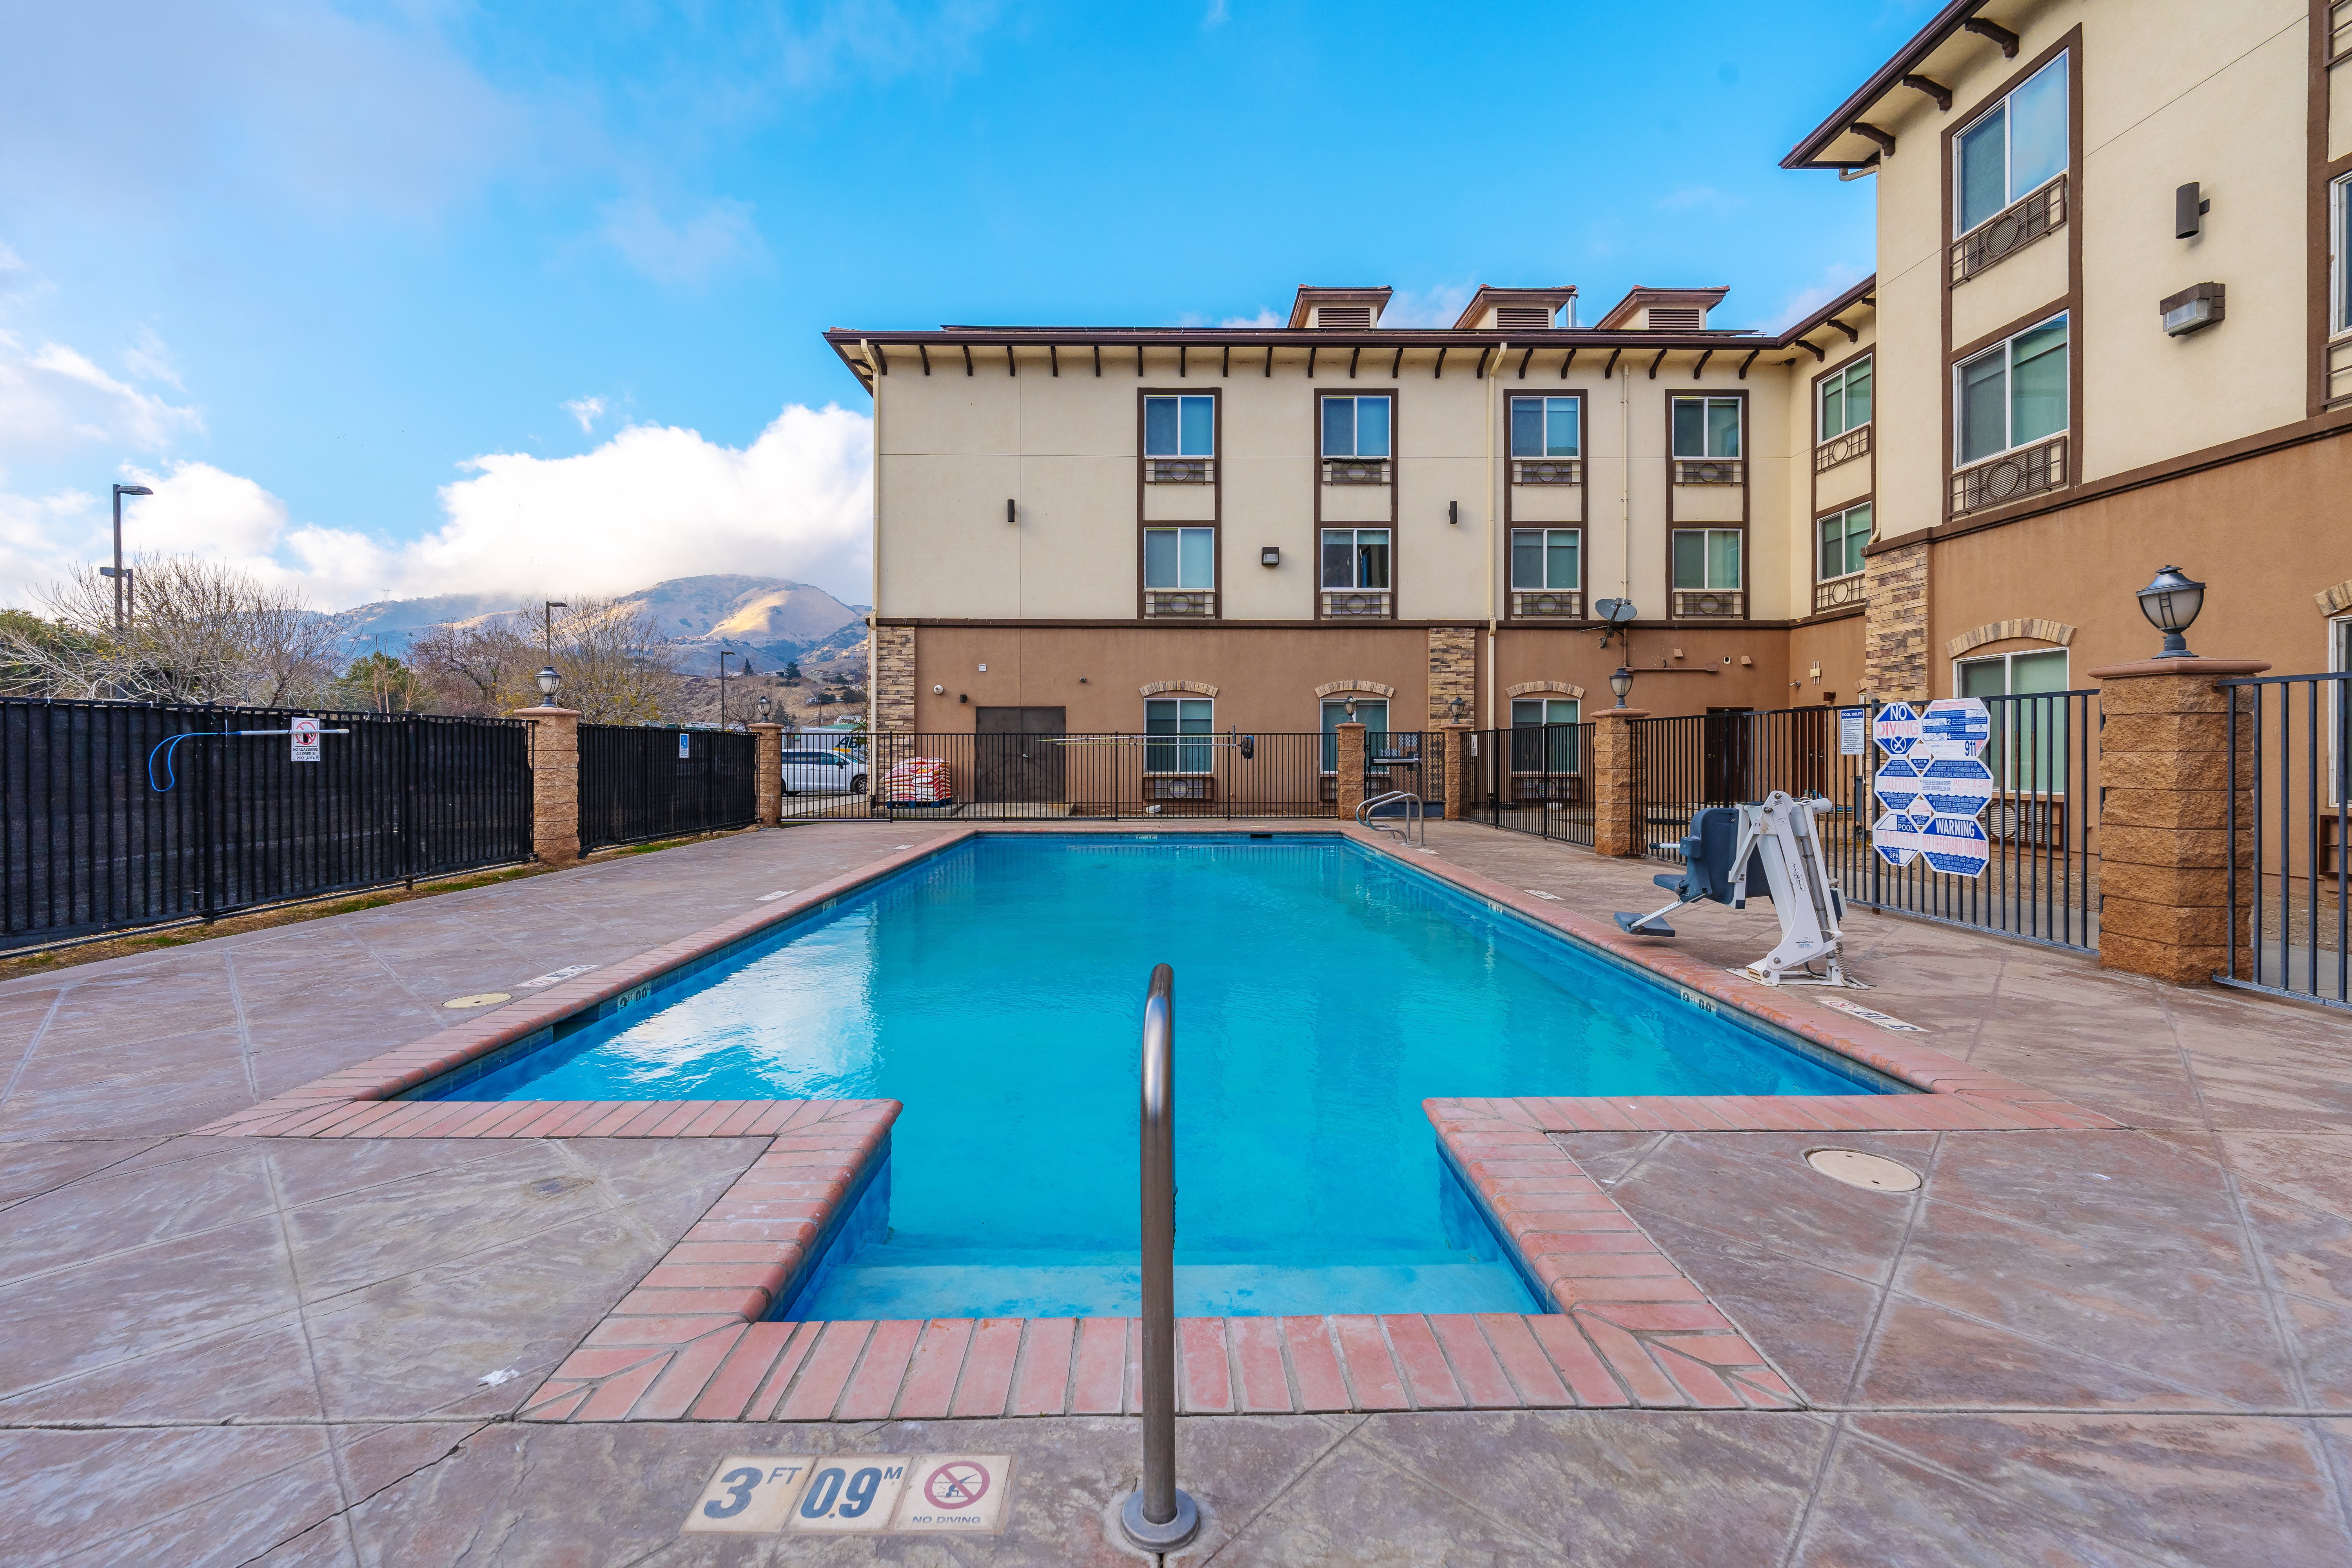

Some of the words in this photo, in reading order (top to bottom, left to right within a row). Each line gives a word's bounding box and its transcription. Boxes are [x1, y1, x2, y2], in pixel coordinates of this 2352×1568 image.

[1890, 705, 1907, 720] NO
[1876, 720, 1918, 736] DIVING
[1965, 740, 1976, 757] 911
[1978, 779, 1989, 788] SPA
[1935, 818, 1975, 837] WARNING
[1877, 831, 1919, 848] CAPACITY
[1922, 835, 1930, 850] NO
[1933, 835, 1963, 854] LIFEGUARD
[1964, 839, 1973, 855] ON
[1975, 840, 1986, 857] DUTY
[619, 997, 627, 1009] 3
[627, 993, 633, 1002] FT
[1682, 991, 1690, 1002] 3
[704, 1467, 763, 1519] 3
[767, 1467, 803, 1485] FT
[936, 1516, 982, 1524] DIVING
